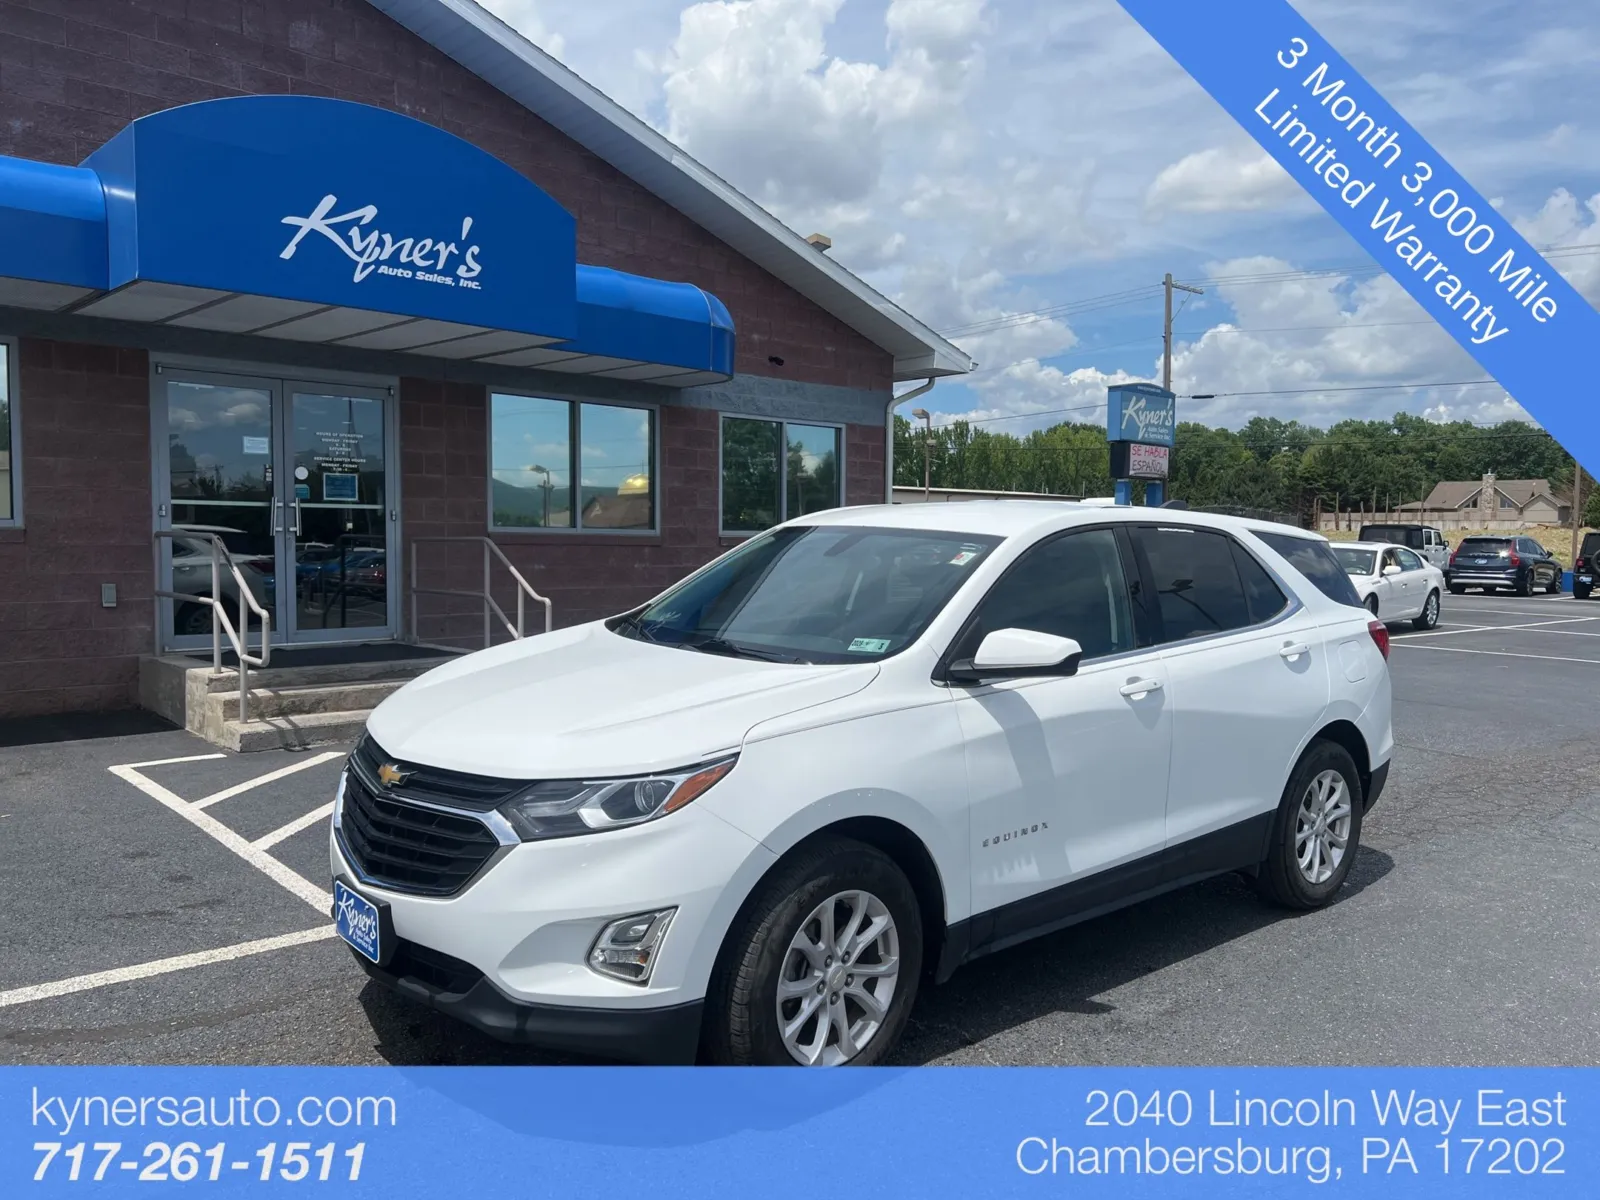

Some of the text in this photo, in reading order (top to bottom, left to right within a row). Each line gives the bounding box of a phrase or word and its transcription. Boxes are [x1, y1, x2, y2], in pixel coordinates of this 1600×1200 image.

[279, 194, 482, 283] Kyner's
[377, 265, 482, 290] Auto Sales, Inc.
[1121, 396, 1173, 440] Kyner's
[1132, 445, 1168, 459] SE HABLA
[982, 822, 1048, 847] EQUINOX
[338, 892, 376, 940] Kyner's
